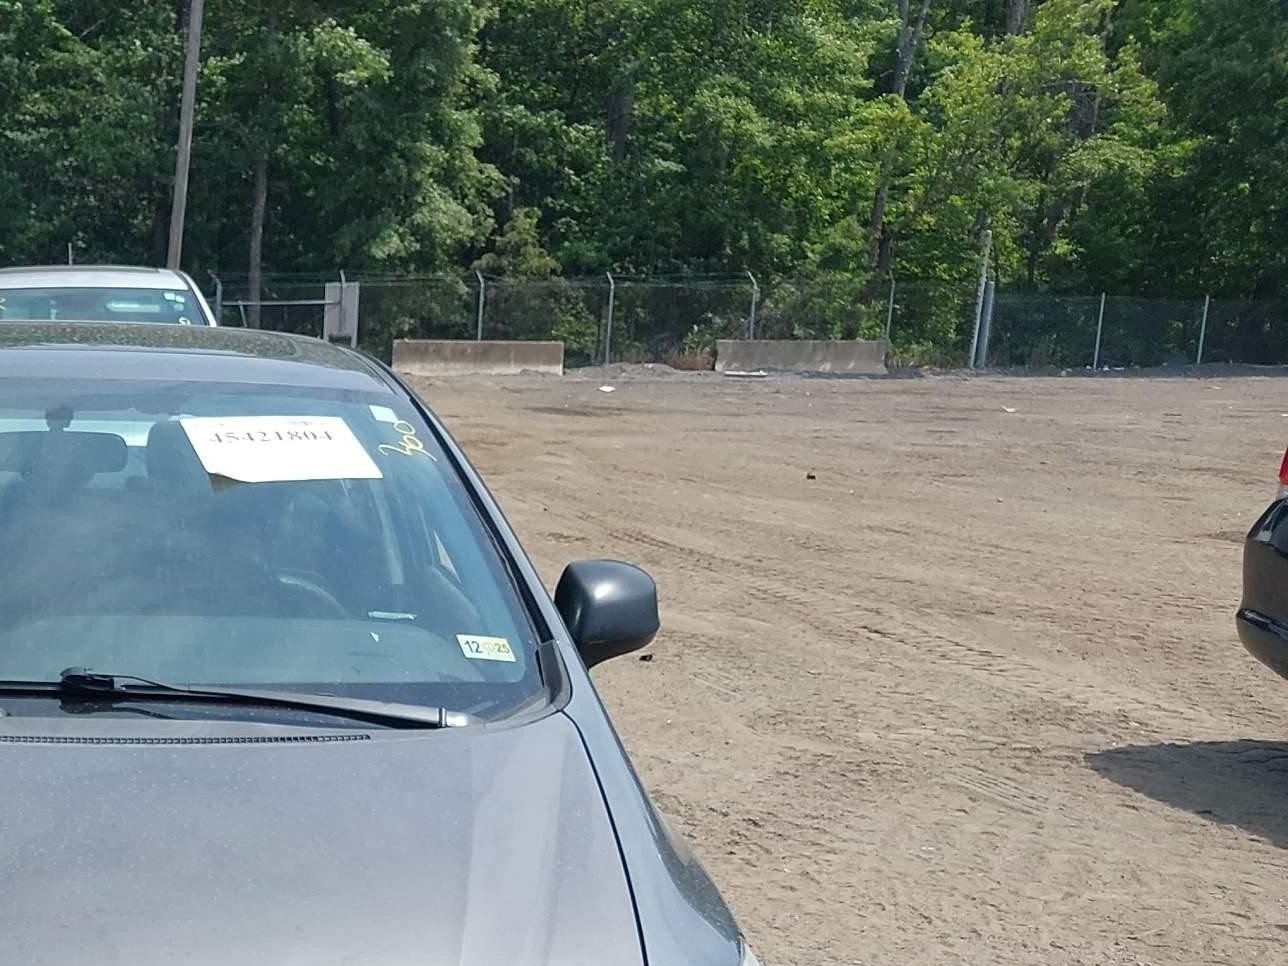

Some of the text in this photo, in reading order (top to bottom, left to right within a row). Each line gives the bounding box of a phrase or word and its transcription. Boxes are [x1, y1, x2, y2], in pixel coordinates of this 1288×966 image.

[209, 430, 334, 444] 45421804
[464, 640, 510, 654] 12 25
